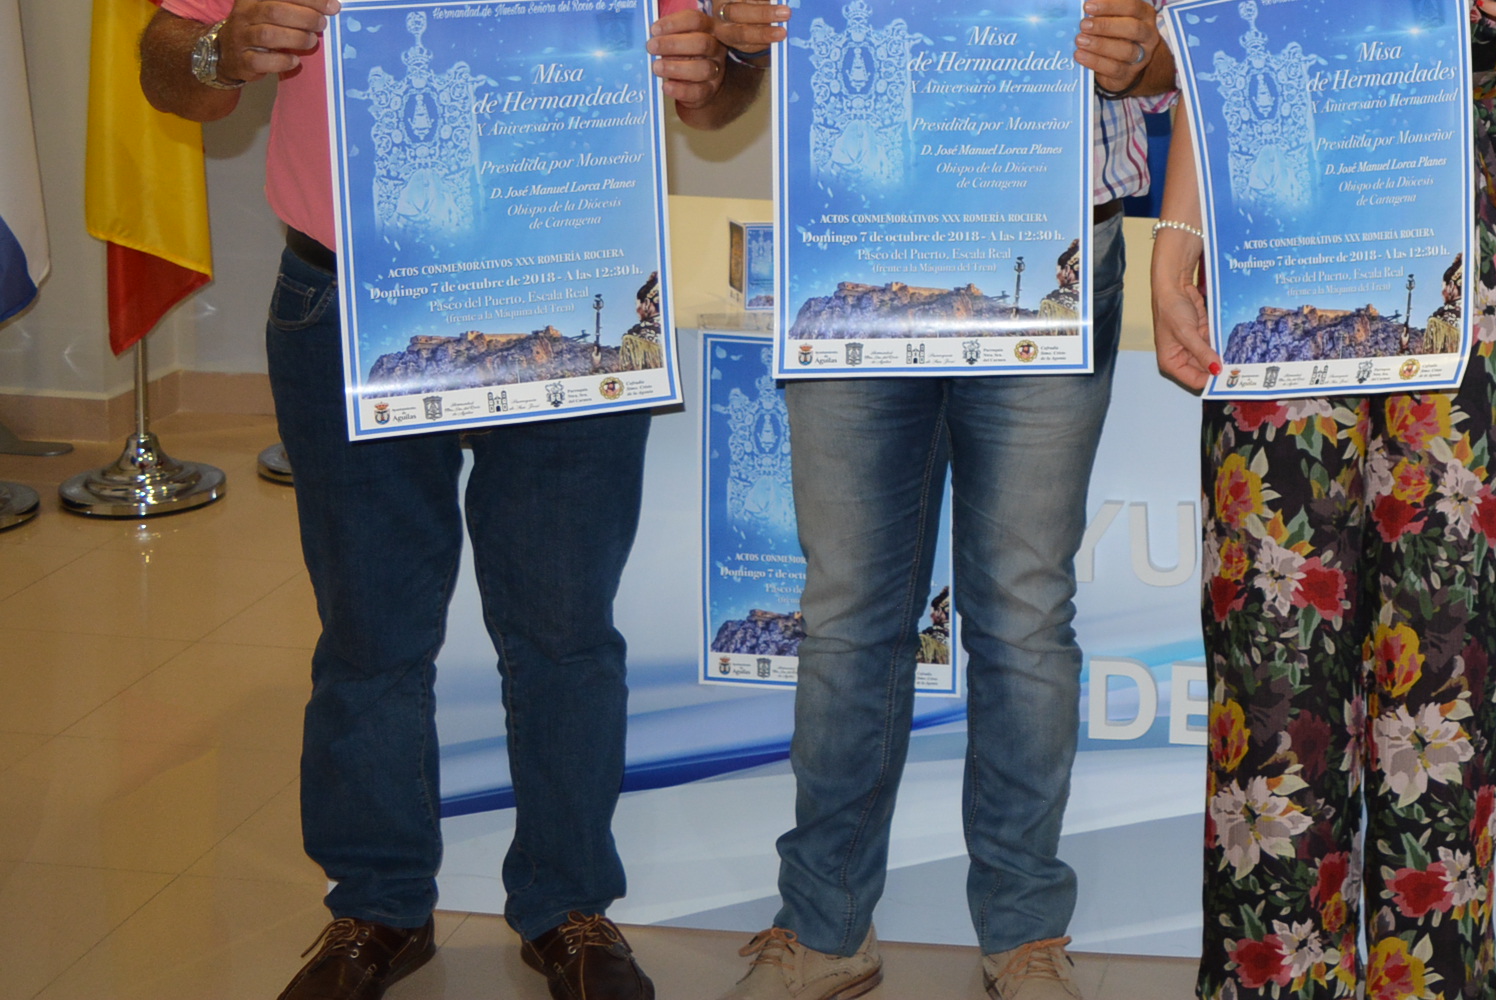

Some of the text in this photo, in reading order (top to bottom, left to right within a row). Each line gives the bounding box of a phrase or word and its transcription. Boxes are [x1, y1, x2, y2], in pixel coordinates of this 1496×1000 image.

[968, 25, 1017, 45] Misa
[906, 50, 1076, 72] de Hermandades
[1358, 41, 1401, 61] Misa
[533, 63, 583, 83] Misa
[1304, 60, 1456, 92] de Hermandades
[470, 84, 645, 115] de Hermandades
[487, 118, 564, 135] Aniversario
[567, 111, 647, 129] Hermandad
[912, 116, 1072, 134] Presidida por Monseñor
[1316, 133, 1371, 150] Presidida
[1397, 128, 1454, 143] Monseñor
[480, 151, 644, 174] Presidida por Monseñor
[504, 185, 528, 198] José
[529, 182, 569, 195] Manuel
[569, 181, 600, 192] Lorca
[602, 178, 636, 189] Planes
[388, 266, 418, 277] ACTOS
[515, 256, 534, 266] XXX
[584, 248, 624, 259] ROCIERA
